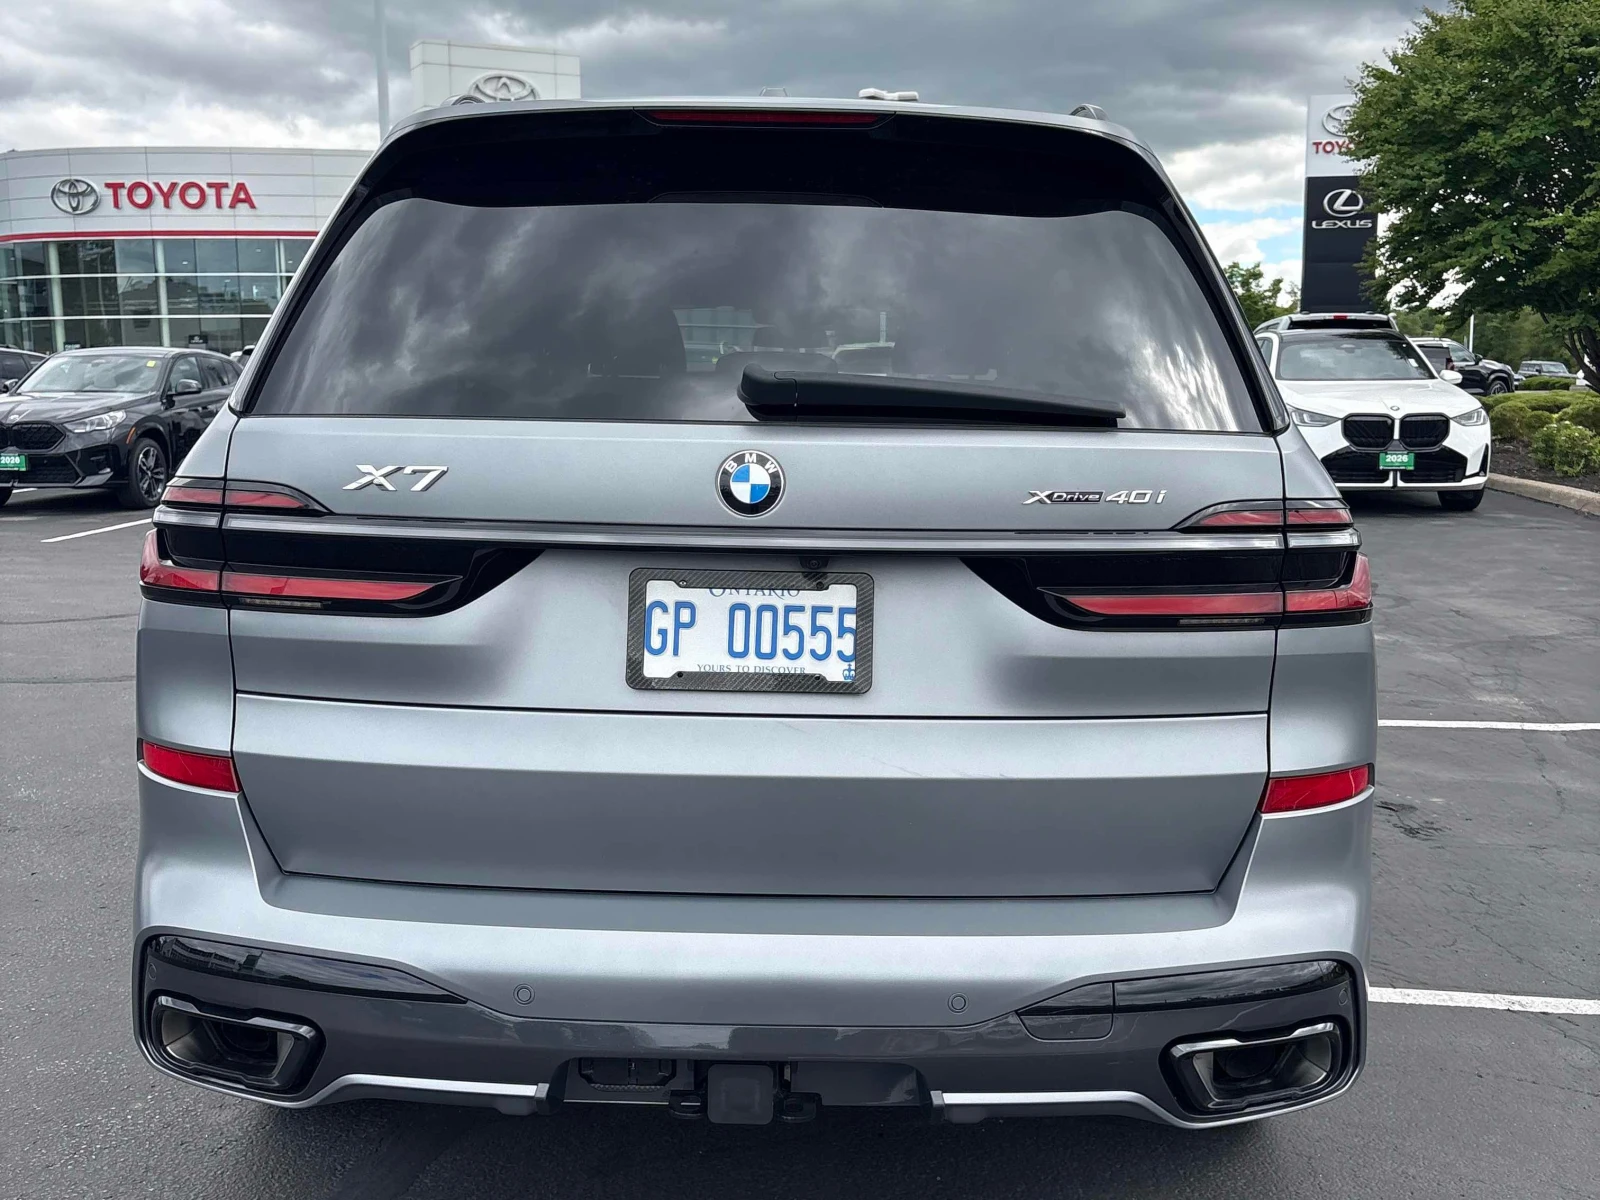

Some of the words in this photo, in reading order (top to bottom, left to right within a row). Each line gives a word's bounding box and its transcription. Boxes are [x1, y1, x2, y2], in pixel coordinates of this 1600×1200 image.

[104, 181, 257, 210] TOYOTA
[1311, 219, 1373, 229] LEXUS
[724, 452, 778, 474] BMW
[1385, 454, 1409, 463] 2026
[341, 464, 449, 492] X7
[645, 600, 697, 656] GP
[727, 602, 857, 663] 00555
[696, 664, 732, 673] YOURS
[736, 664, 750, 673] TO
[753, 665, 806, 674] DISCOVER
